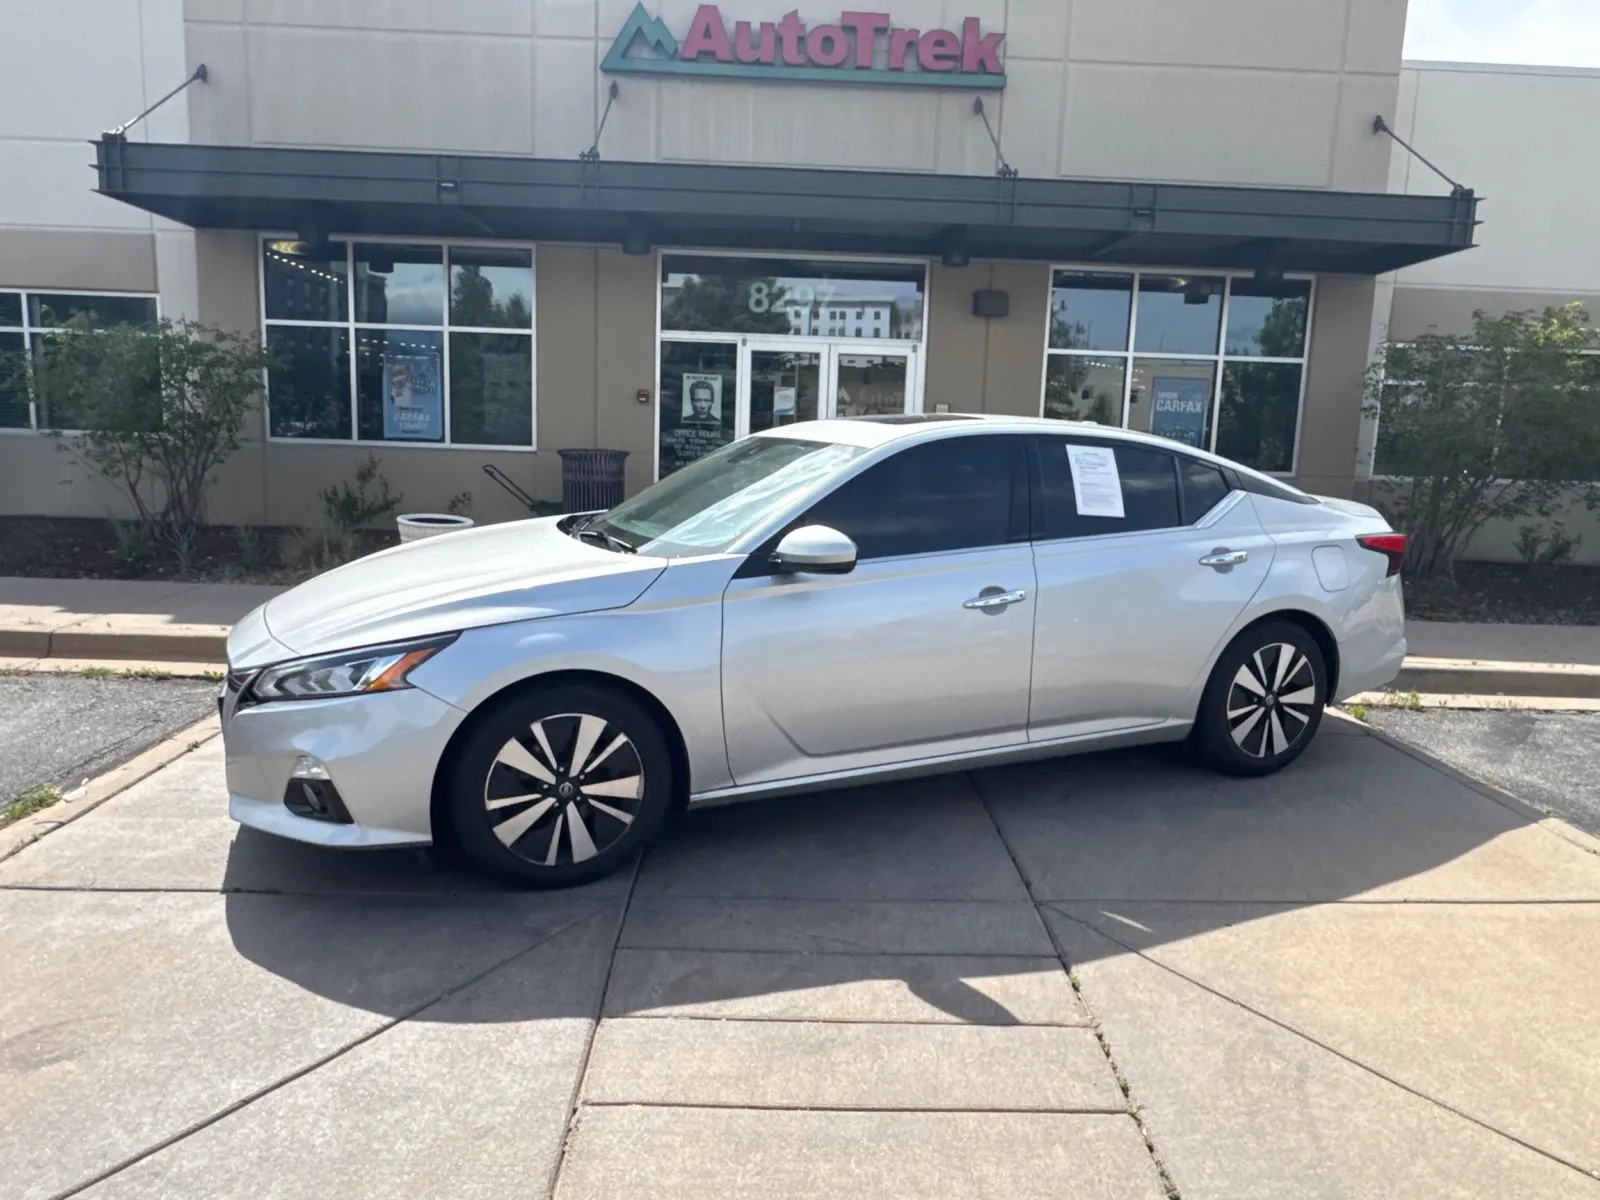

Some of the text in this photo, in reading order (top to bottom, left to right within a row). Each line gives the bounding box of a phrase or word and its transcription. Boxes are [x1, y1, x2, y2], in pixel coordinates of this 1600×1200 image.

[681, 4, 1006, 74] AutoTrek
[748, 281, 836, 315] 8297
[1156, 391, 1179, 400] SHOW
[1156, 399, 1202, 413] CARFAX
[674, 428, 721, 439] OFFICE HOURS
